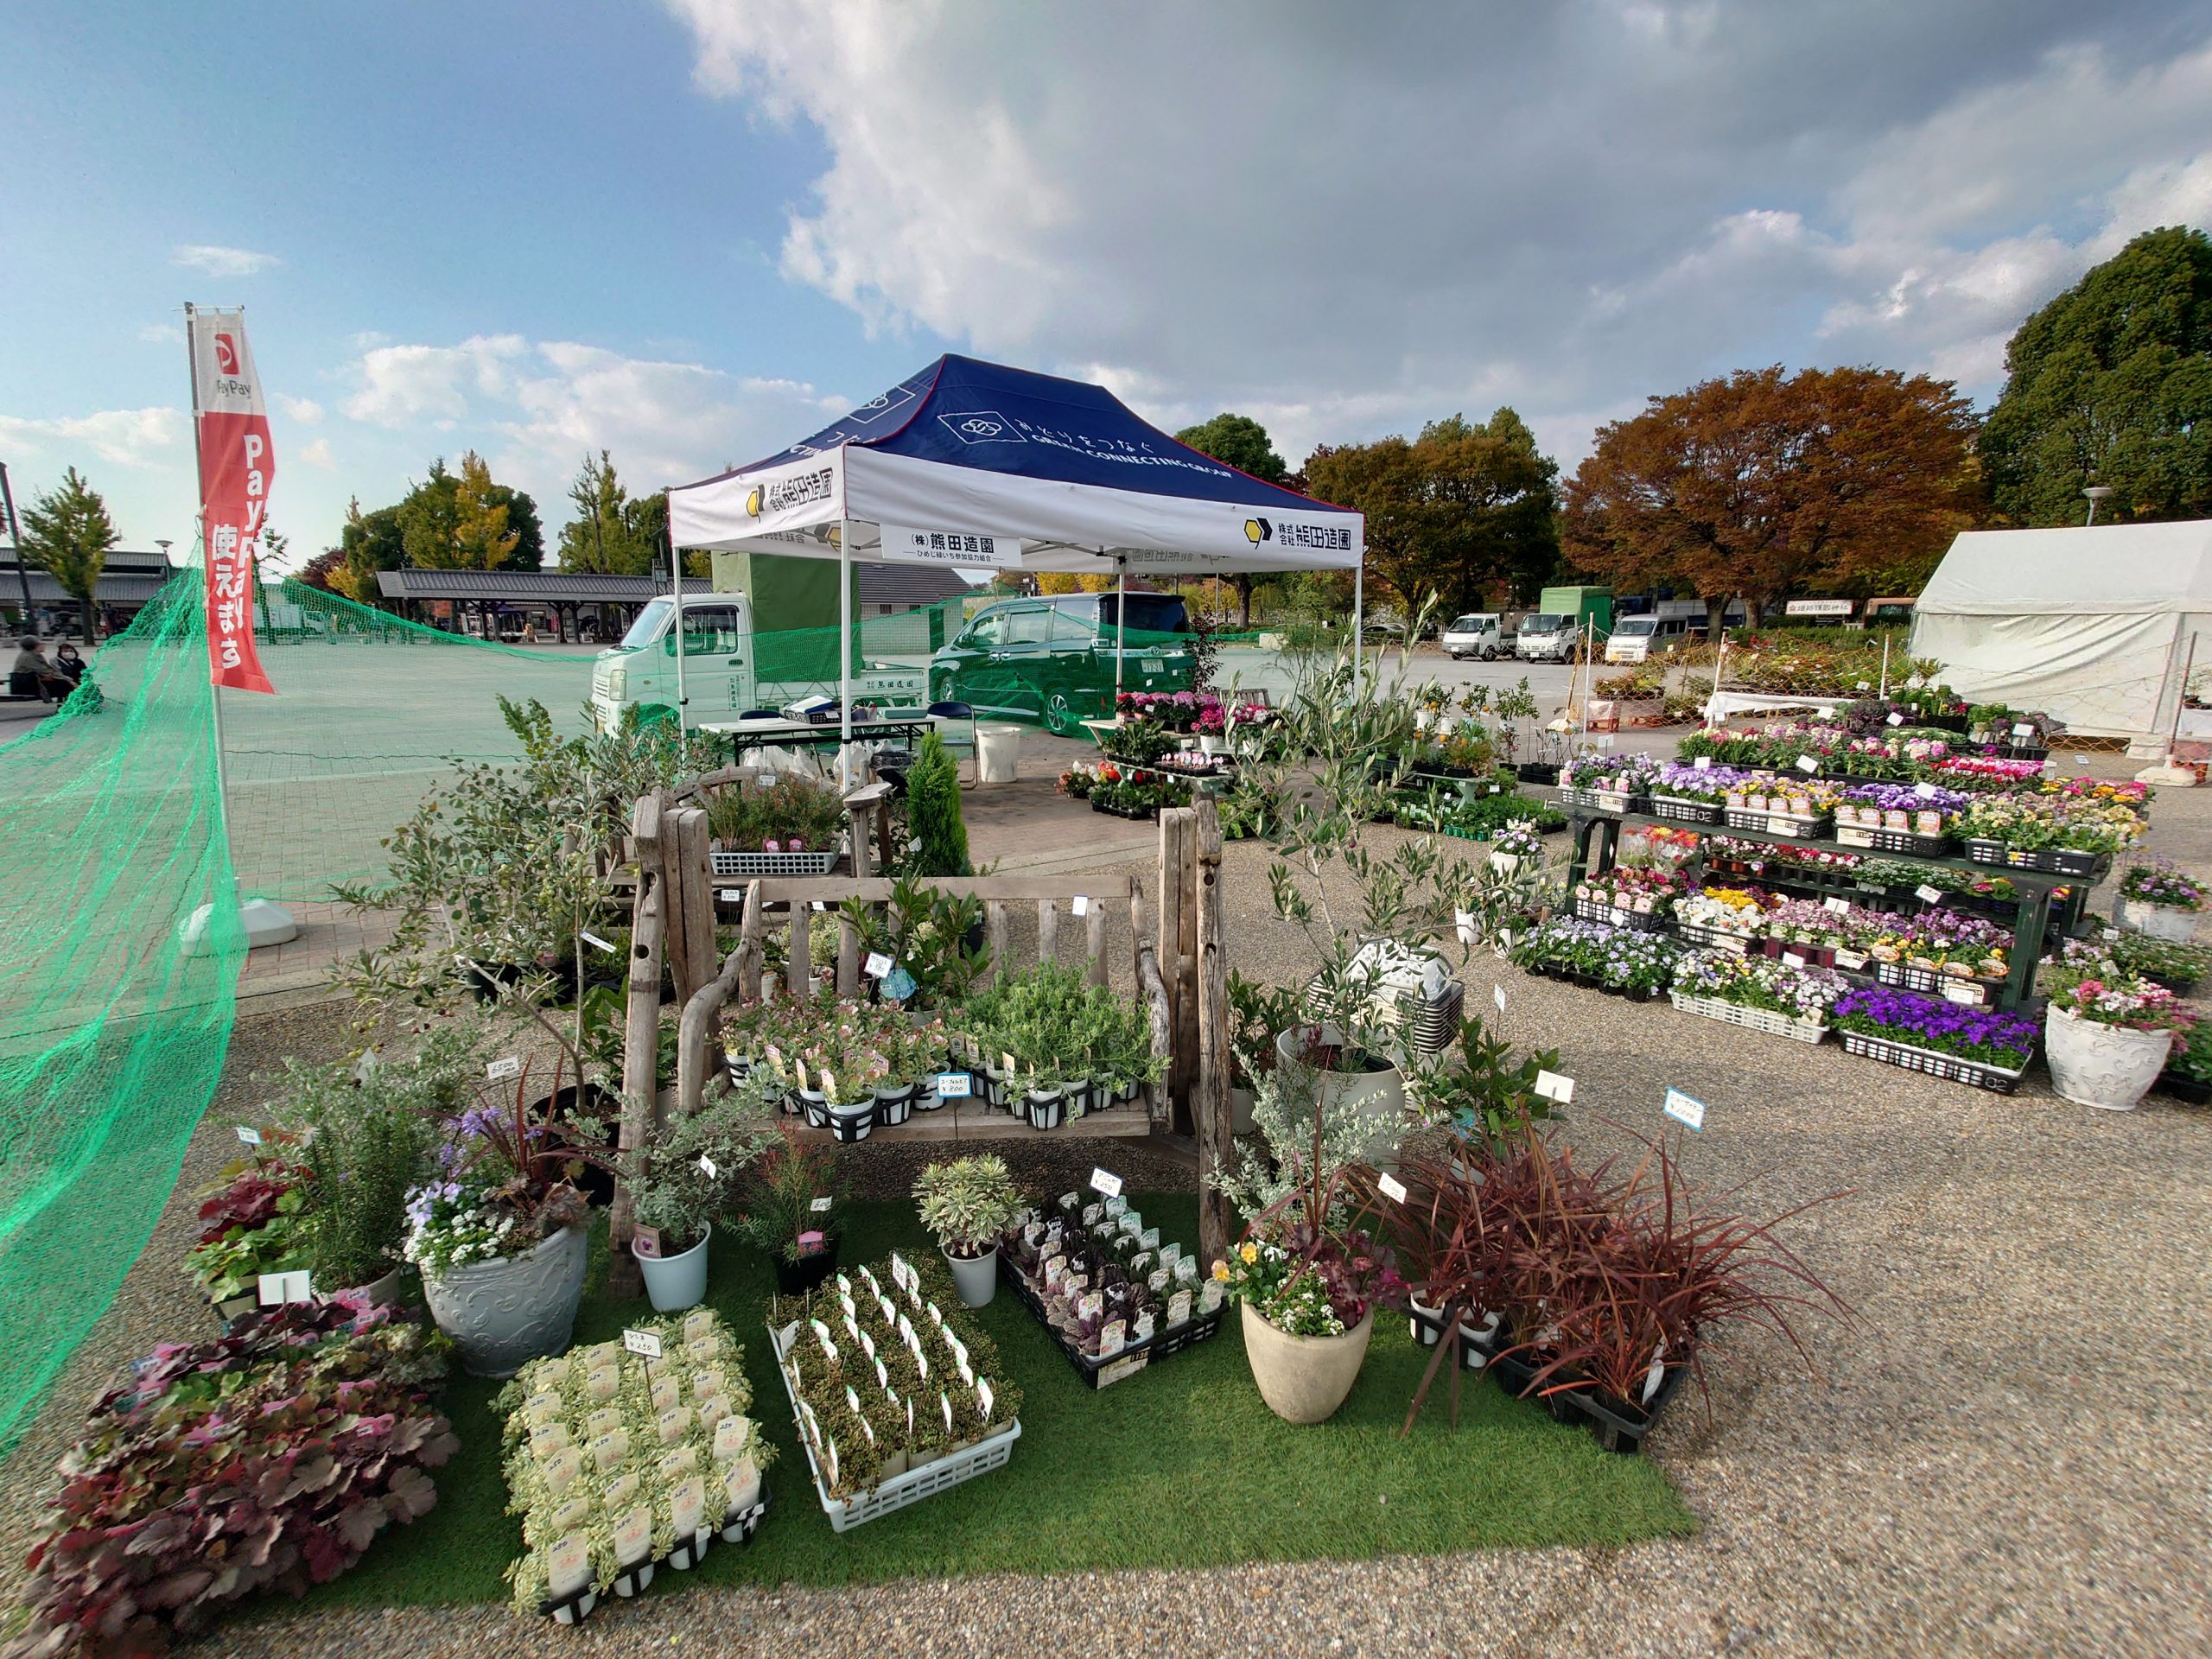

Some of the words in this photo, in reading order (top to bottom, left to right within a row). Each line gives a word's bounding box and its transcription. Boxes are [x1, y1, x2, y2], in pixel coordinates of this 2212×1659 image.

[1086, 449, 1189, 469] CONNECTING
[1295, 524, 1351, 550] 熊田造園
[212, 524, 242, 669] 使えます
[492, 1061, 514, 1074] 6500
